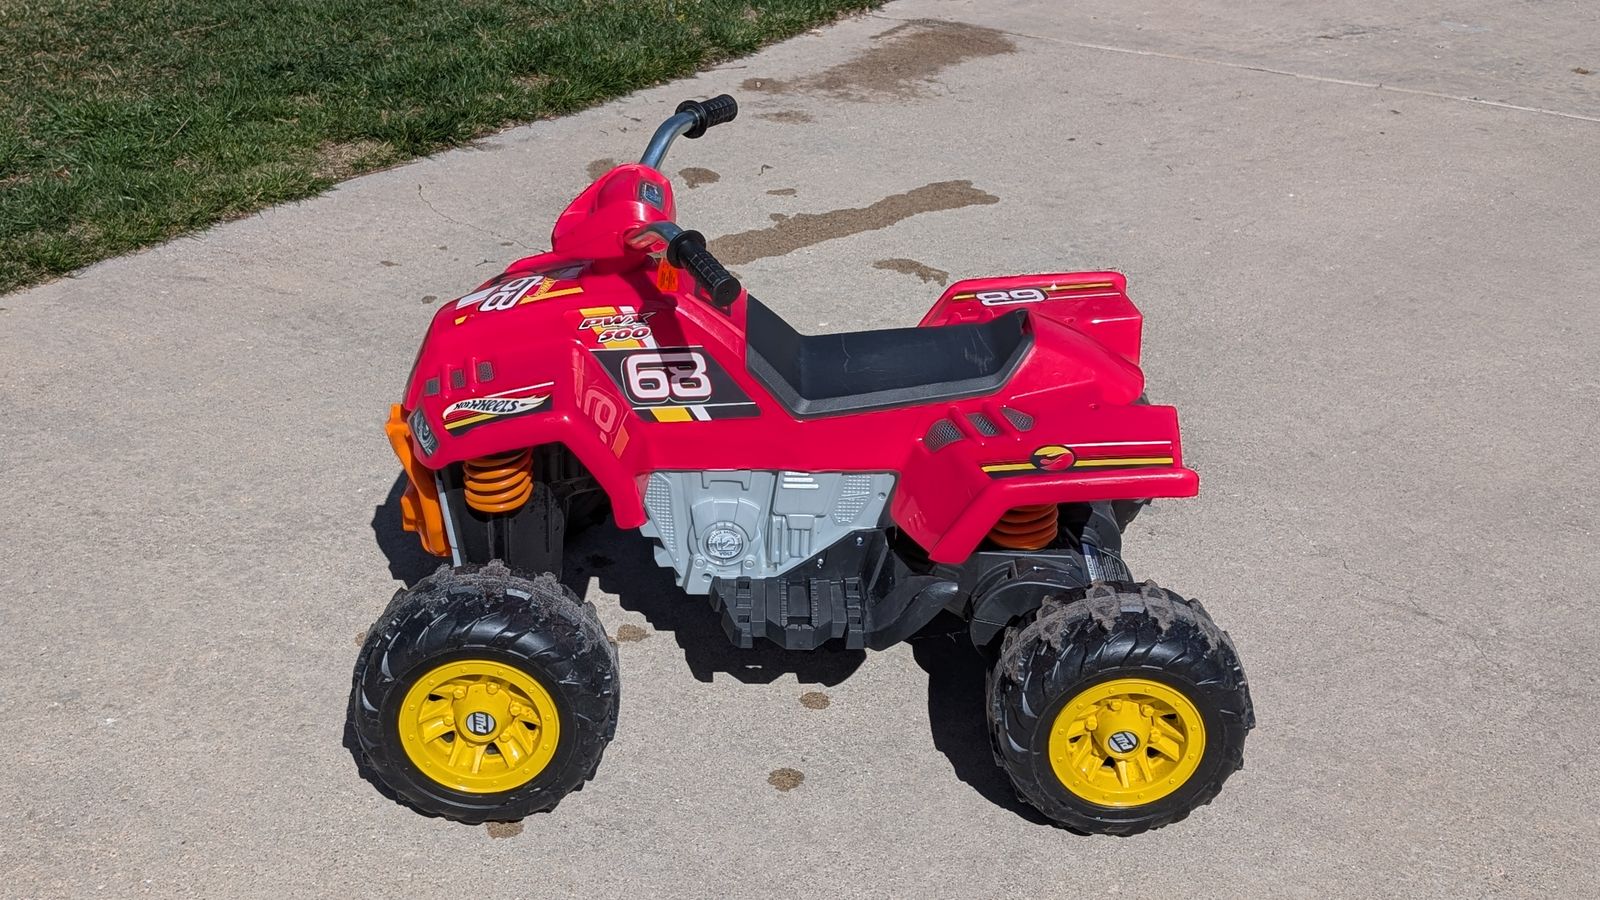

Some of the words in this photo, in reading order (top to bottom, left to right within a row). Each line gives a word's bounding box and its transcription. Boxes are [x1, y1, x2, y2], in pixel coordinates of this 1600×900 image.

[578, 311, 656, 330] PWX
[597, 326, 651, 343] 500
[626, 351, 713, 400] 68
